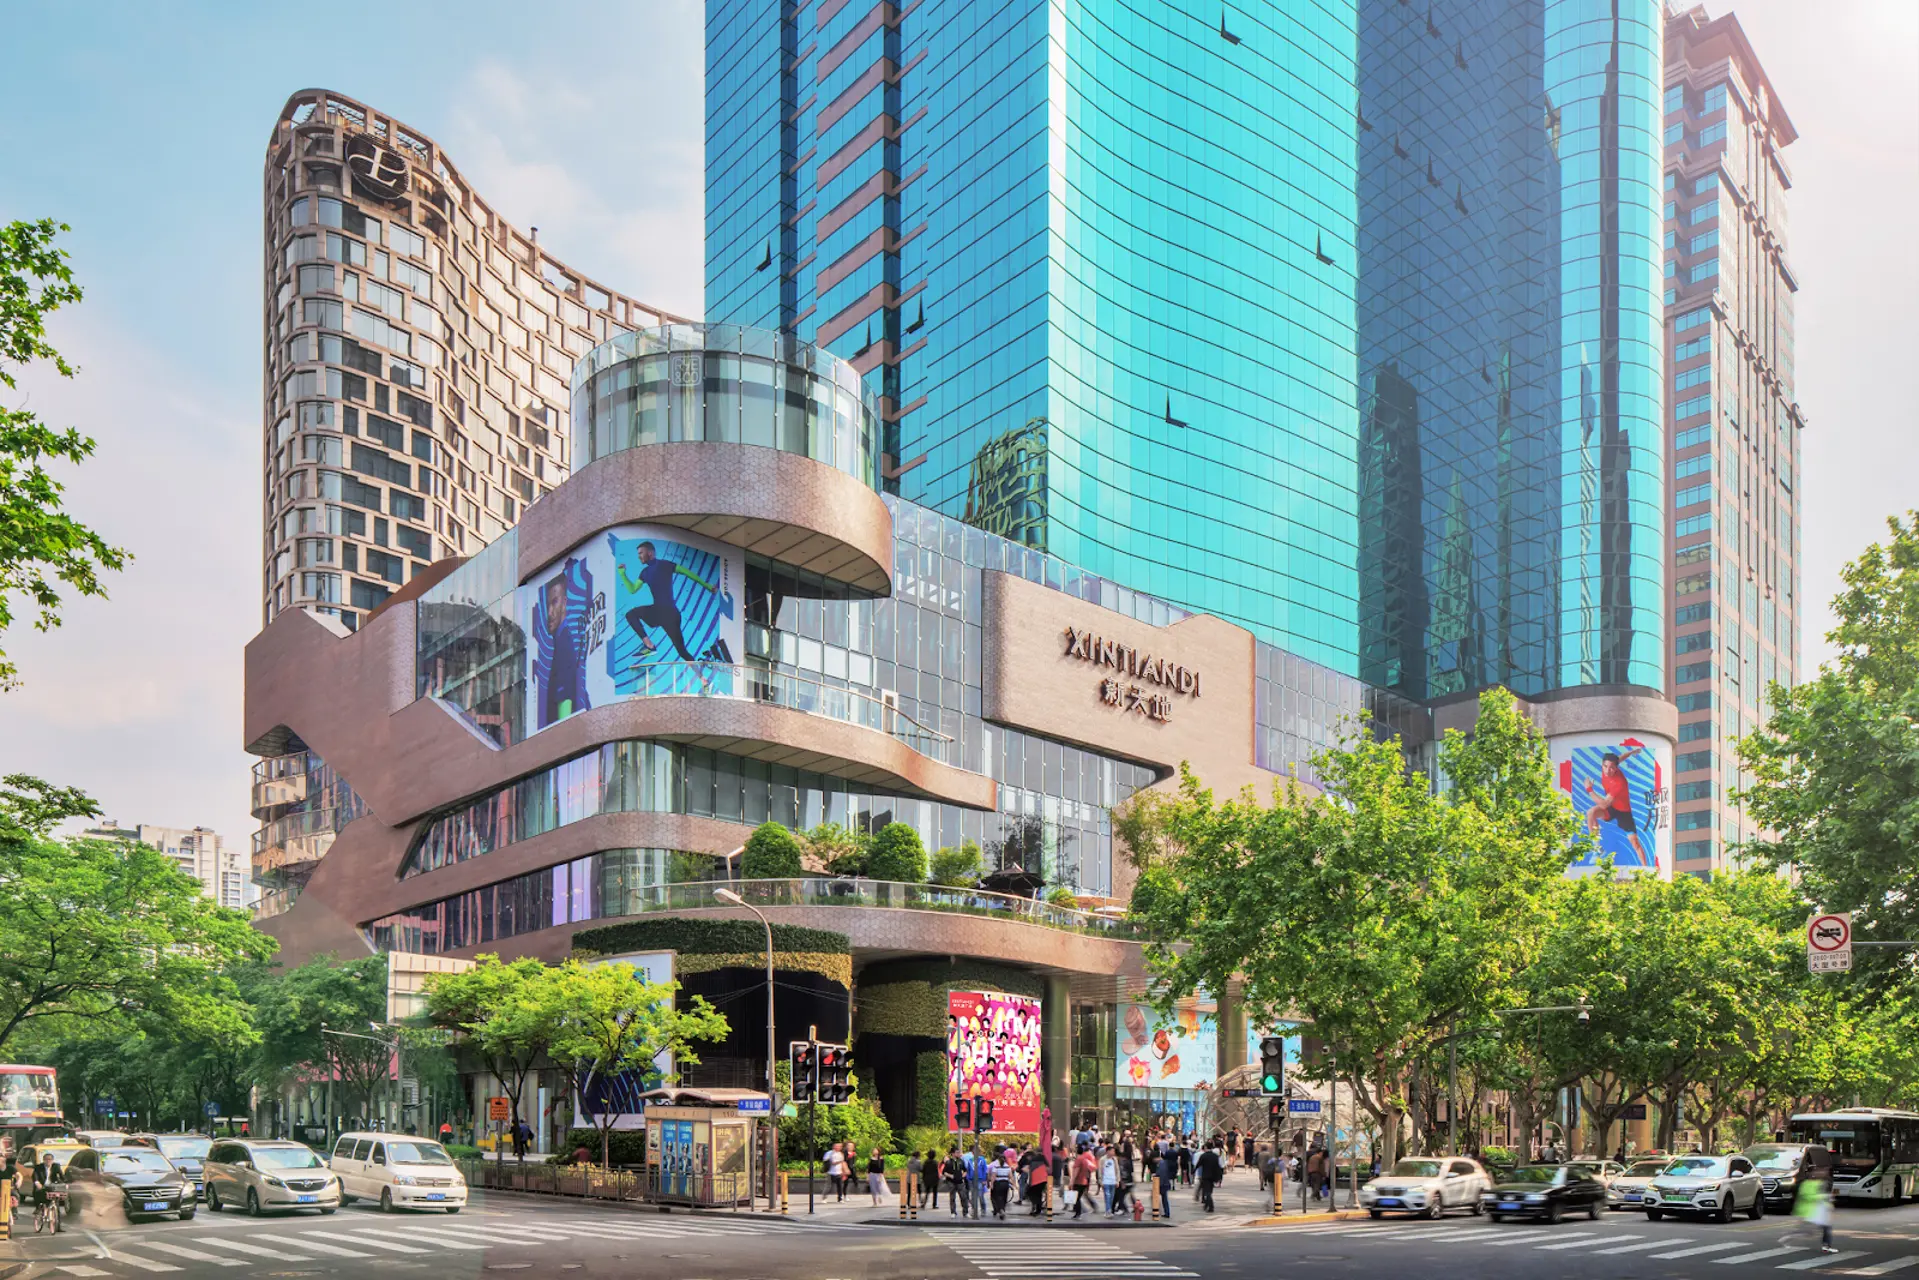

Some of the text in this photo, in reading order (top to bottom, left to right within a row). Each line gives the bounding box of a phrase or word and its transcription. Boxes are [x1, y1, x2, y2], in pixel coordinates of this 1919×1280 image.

[1065, 626, 1201, 697] XINTIANDI
[1102, 677, 1172, 723] 新天地
[970, 1039, 1038, 1073] HERE
